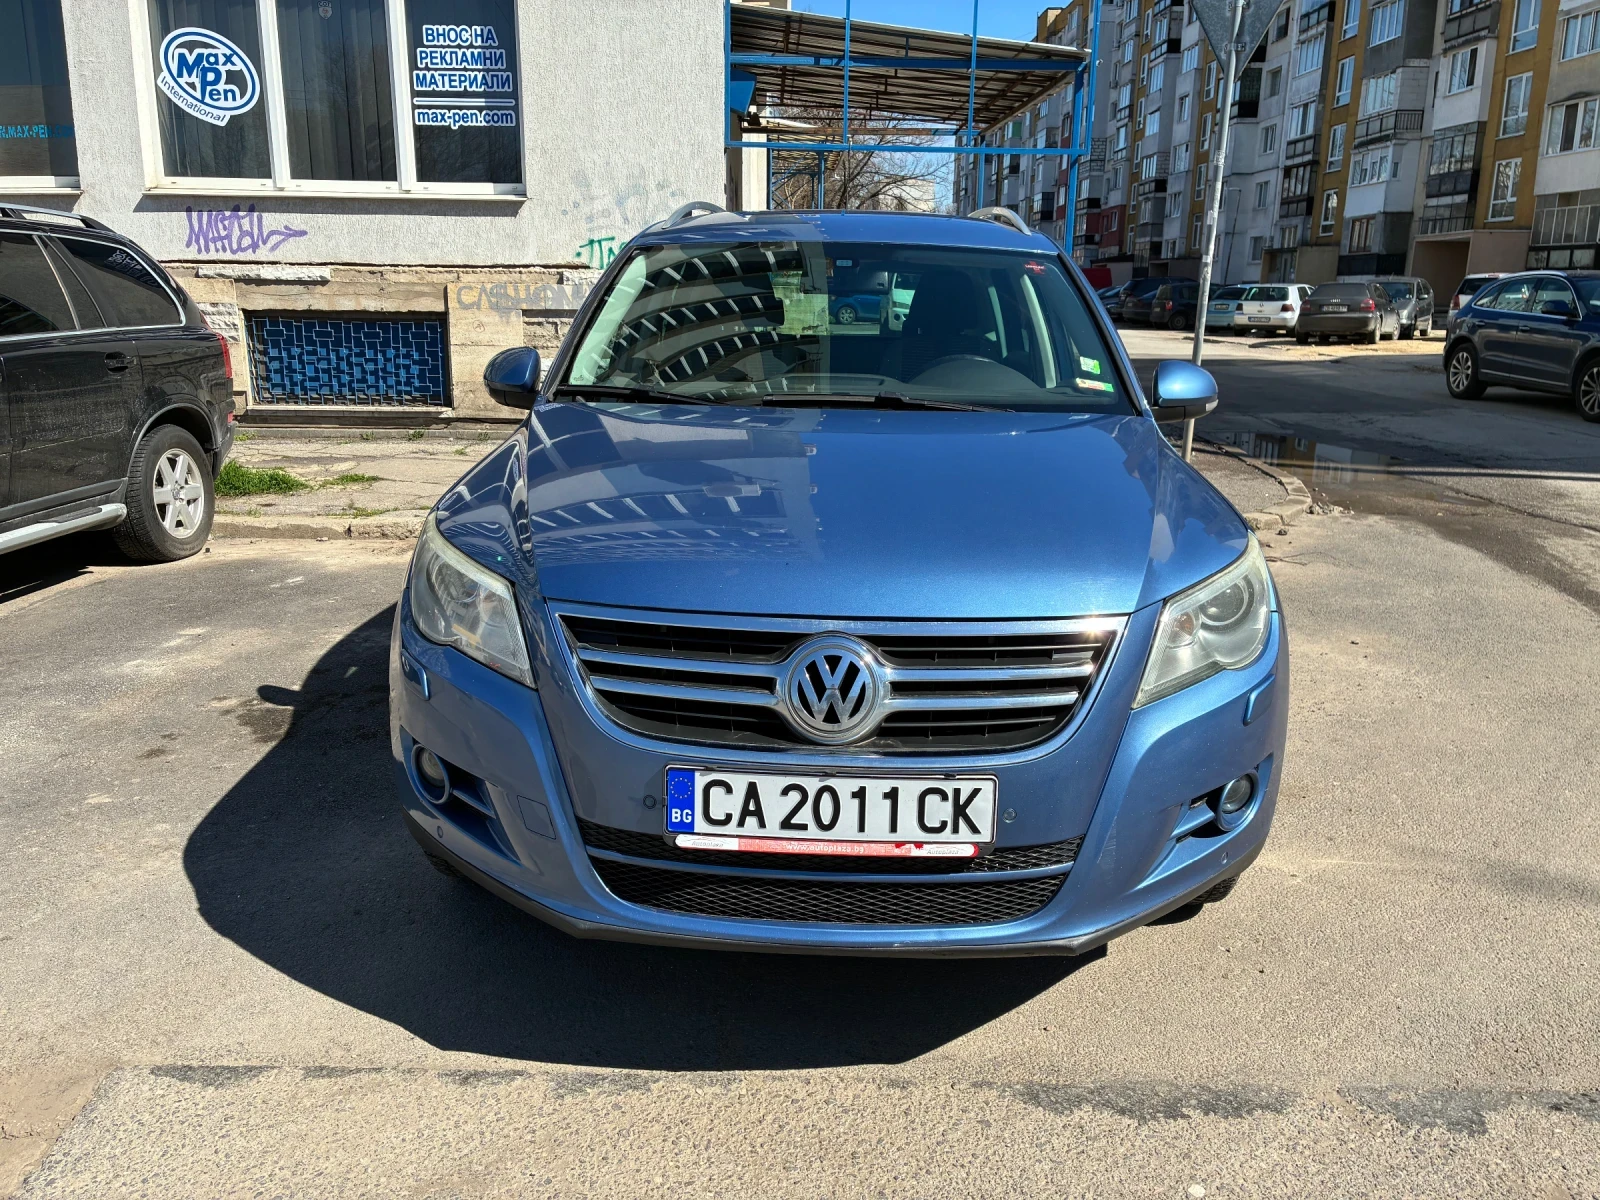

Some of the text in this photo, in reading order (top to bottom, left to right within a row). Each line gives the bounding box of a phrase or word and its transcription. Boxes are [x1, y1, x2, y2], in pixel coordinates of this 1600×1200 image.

[424, 26, 498, 45] ВНОС НА
[176, 52, 238, 79] Max
[417, 48, 506, 69] РЕКЛАМНИ
[199, 64, 237, 102] Pen
[413, 71, 513, 91] МАТЕРИАЛИ
[160, 75, 228, 123] International
[415, 109, 516, 129] max-pen.com
[671, 808, 692, 823] BG
[702, 779, 982, 835] CA 2011 CK
